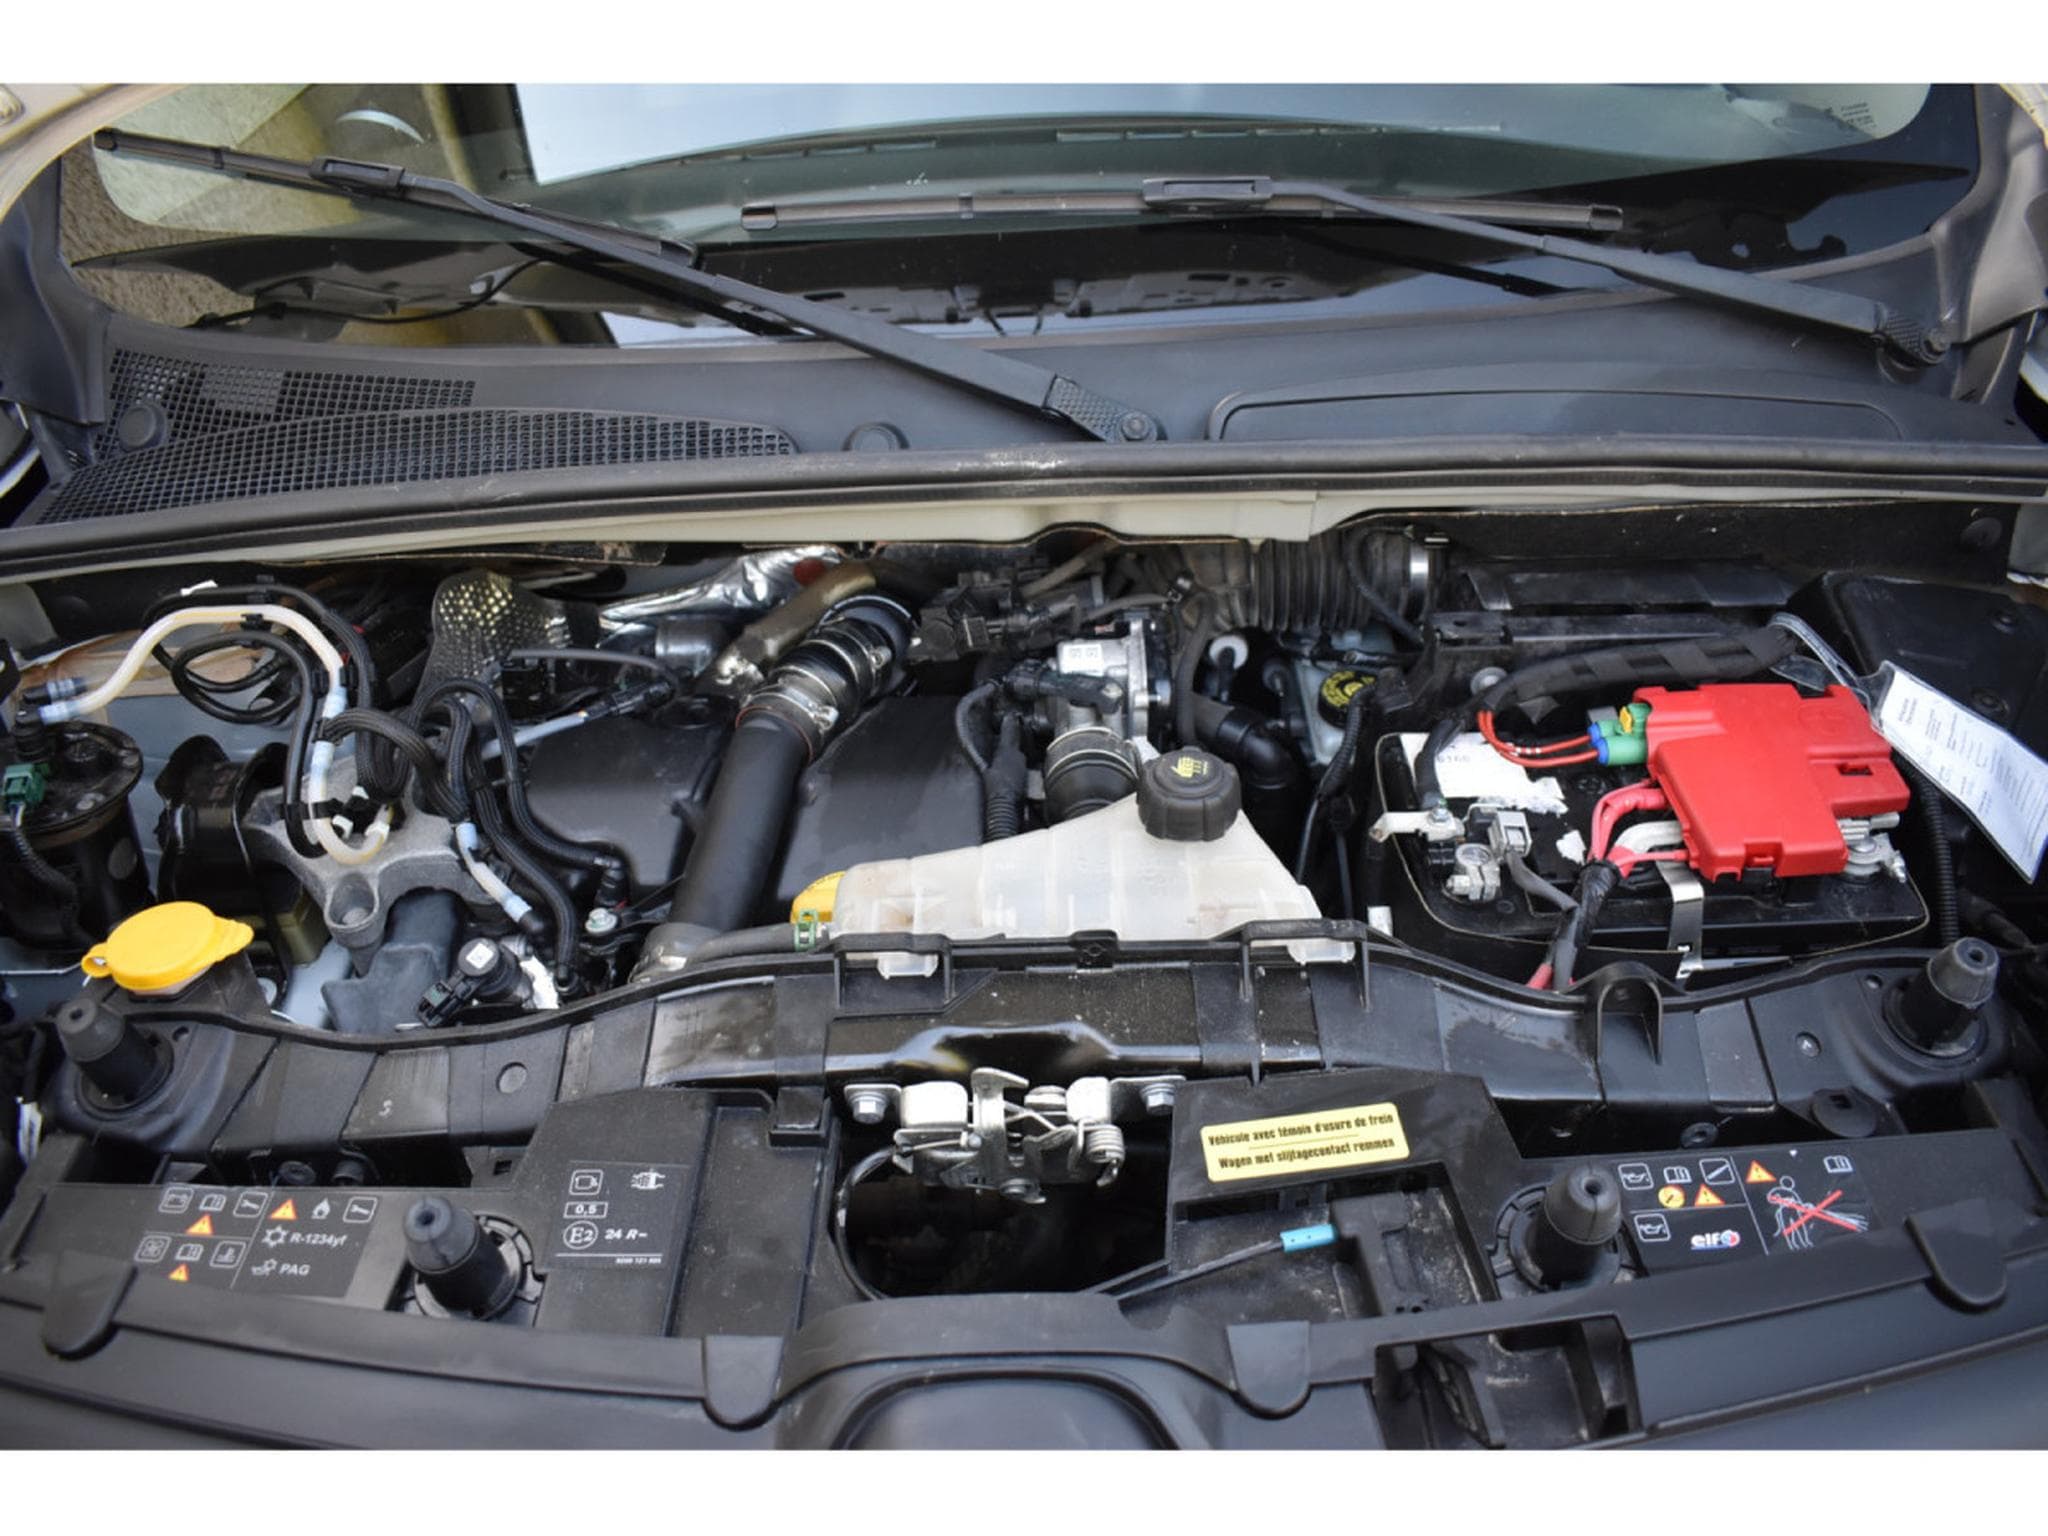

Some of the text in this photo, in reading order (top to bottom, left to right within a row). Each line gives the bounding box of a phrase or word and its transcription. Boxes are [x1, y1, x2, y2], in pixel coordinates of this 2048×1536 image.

[1208, 1113, 1394, 1146] Véhicule avec témoin d'usure de frein
[1218, 1138, 1396, 1169] Wagen met slijtagecontact remmen
[290, 1232, 347, 1248] R-1234yf
[569, 1226, 594, 1244] E2
[604, 1228, 622, 1240] 24
[1690, 1231, 1722, 1249] elf
[280, 1263, 310, 1275] PAG
